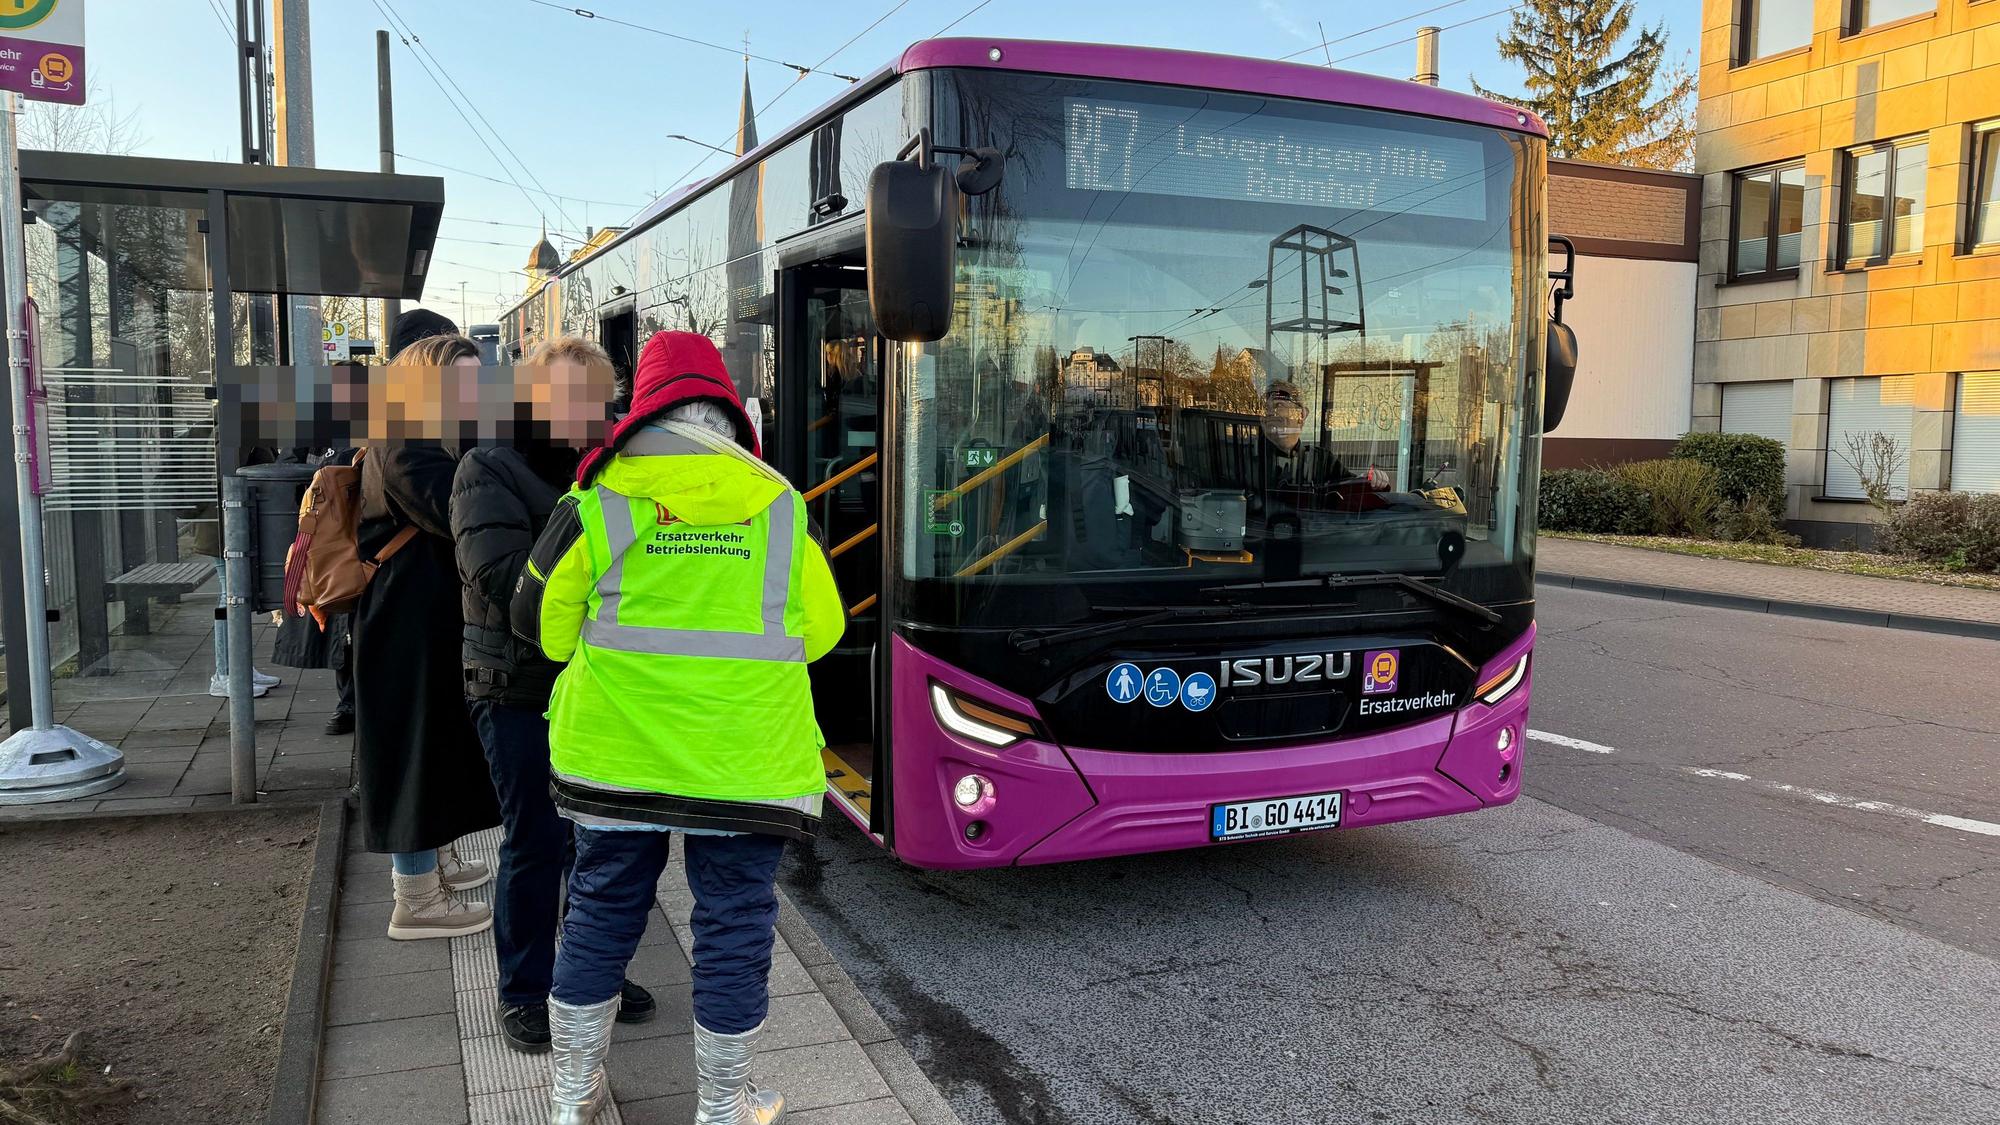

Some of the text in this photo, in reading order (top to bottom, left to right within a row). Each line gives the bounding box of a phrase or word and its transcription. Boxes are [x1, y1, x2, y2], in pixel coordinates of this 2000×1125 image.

[1070, 104, 1138, 190] RE7
[1177, 124, 1448, 181] Leverkusen Mitte
[1246, 166, 1380, 207] Bahnhof
[646, 543, 751, 560] Betriebslenkung
[655, 531, 745, 543] Ersatzverkehr
[1219, 652, 1352, 688] ISUZU
[1359, 690, 1456, 715] Ersatzverkehr
[1226, 797, 1337, 831] BI GO 4414
